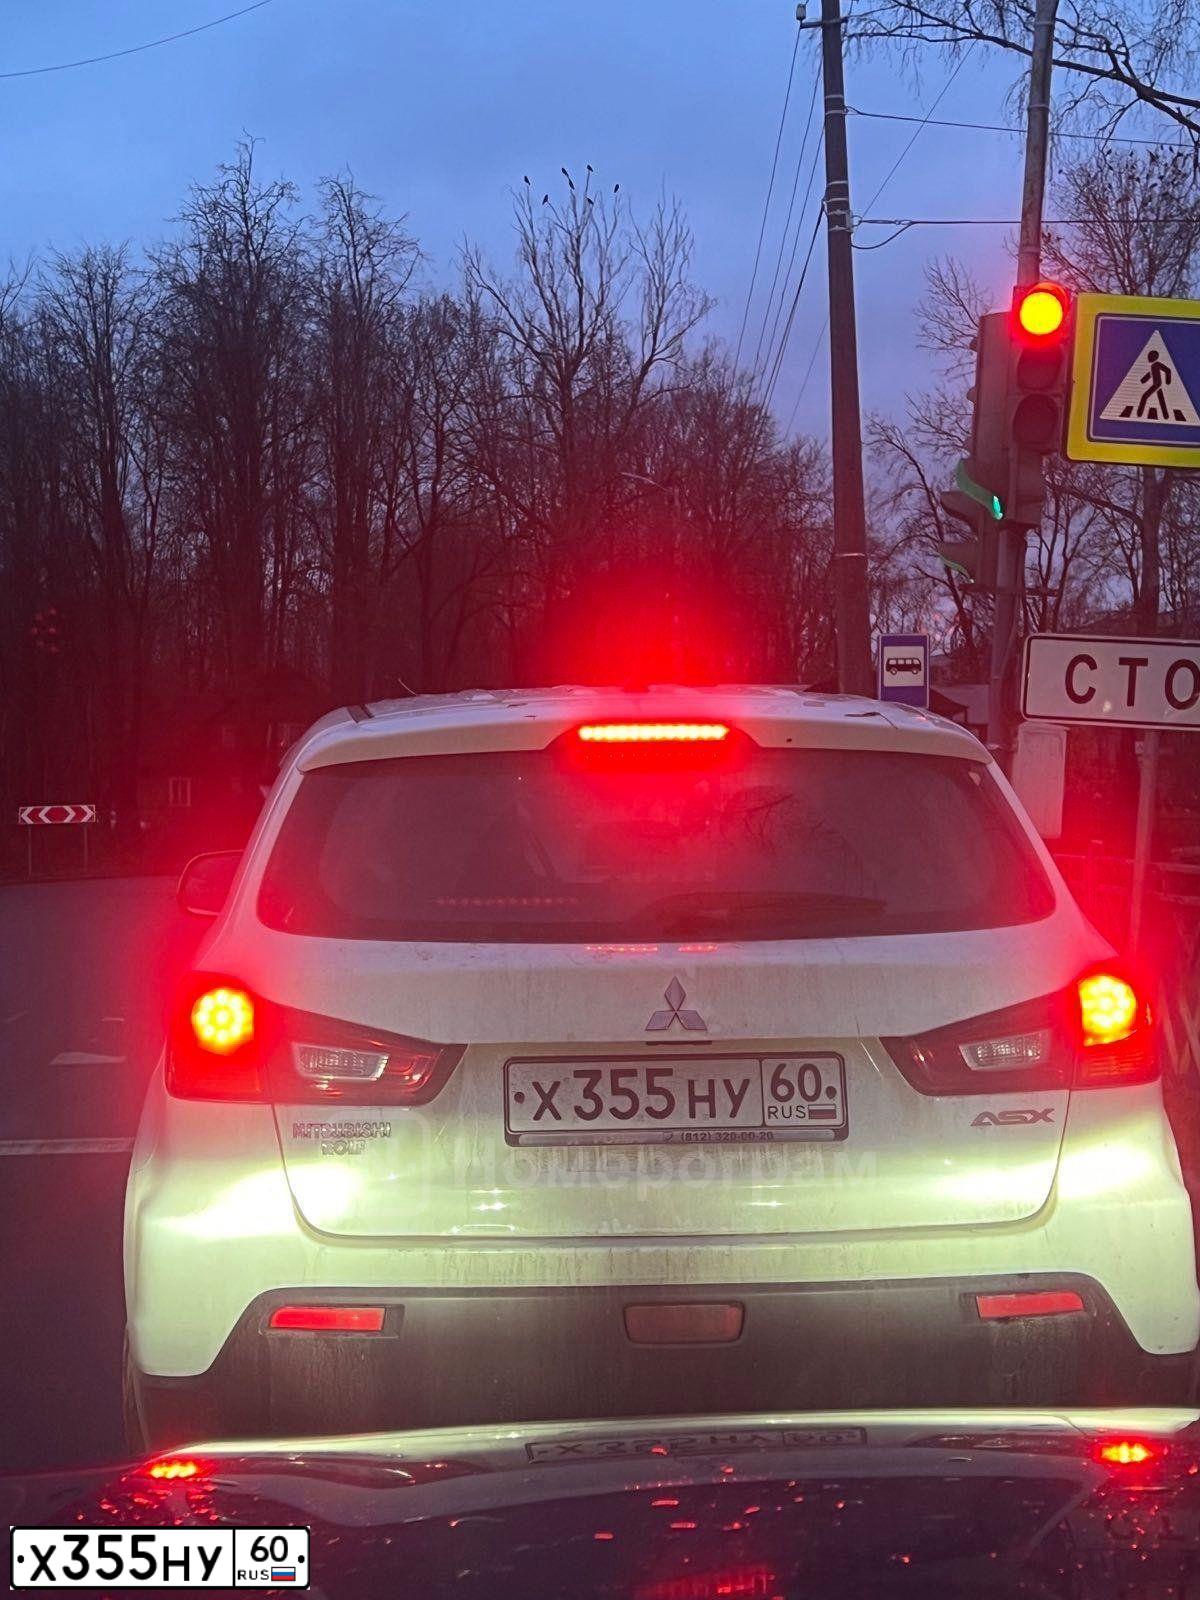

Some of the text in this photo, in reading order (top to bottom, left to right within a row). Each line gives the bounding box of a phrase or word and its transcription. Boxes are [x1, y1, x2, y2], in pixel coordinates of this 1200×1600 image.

[1064, 653, 1200, 711] СТО
[770, 1062, 822, 1103] 60
[767, 1104, 806, 1120] RUS
[970, 1107, 1056, 1127] ASX
[292, 1121, 391, 1139] MITSUBISHI
